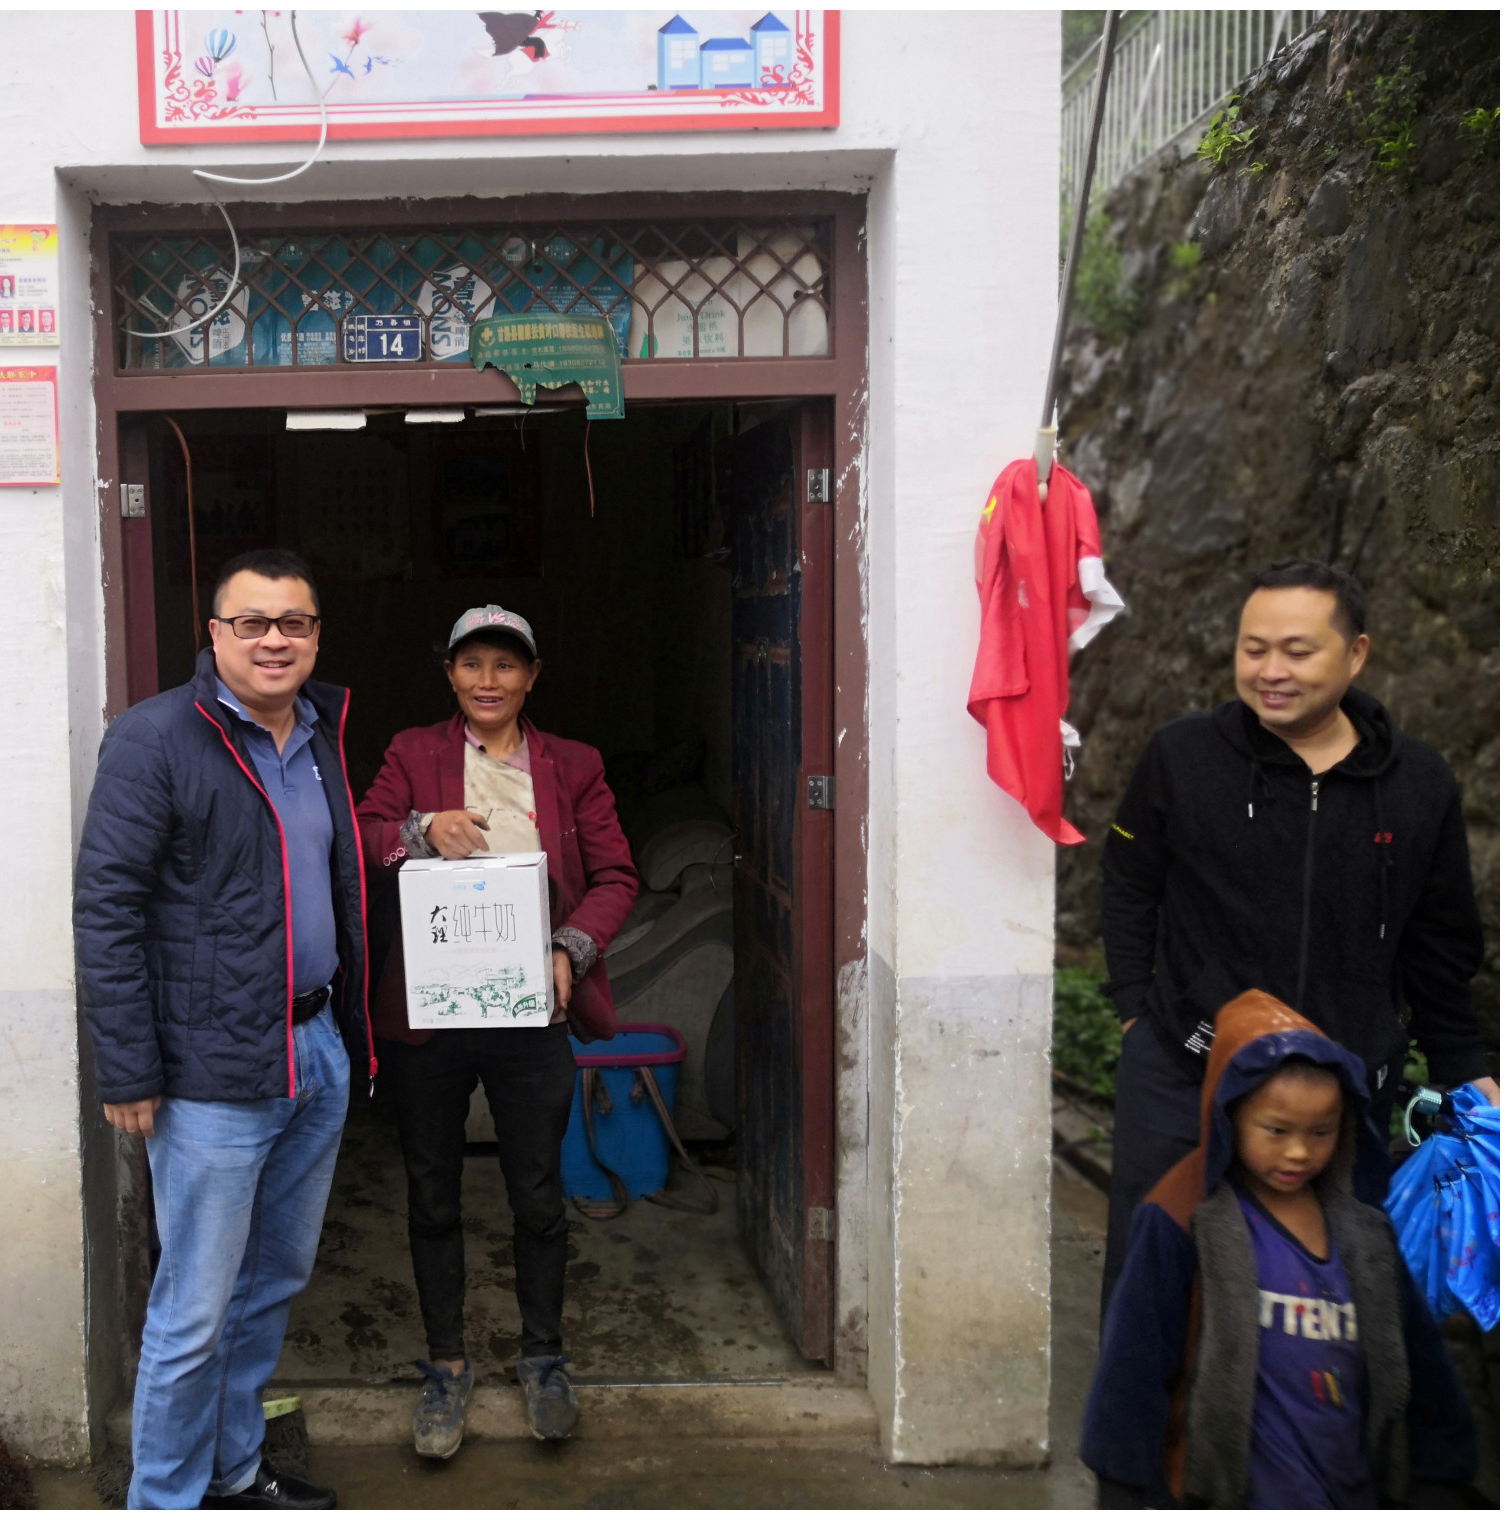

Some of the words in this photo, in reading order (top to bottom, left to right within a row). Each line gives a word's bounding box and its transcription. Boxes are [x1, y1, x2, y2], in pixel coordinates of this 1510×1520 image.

[431, 271, 452, 347] SNOW
[700, 310, 725, 320] Drink
[380, 333, 404, 356] 14
[452, 902, 517, 943] 纯牛奶
